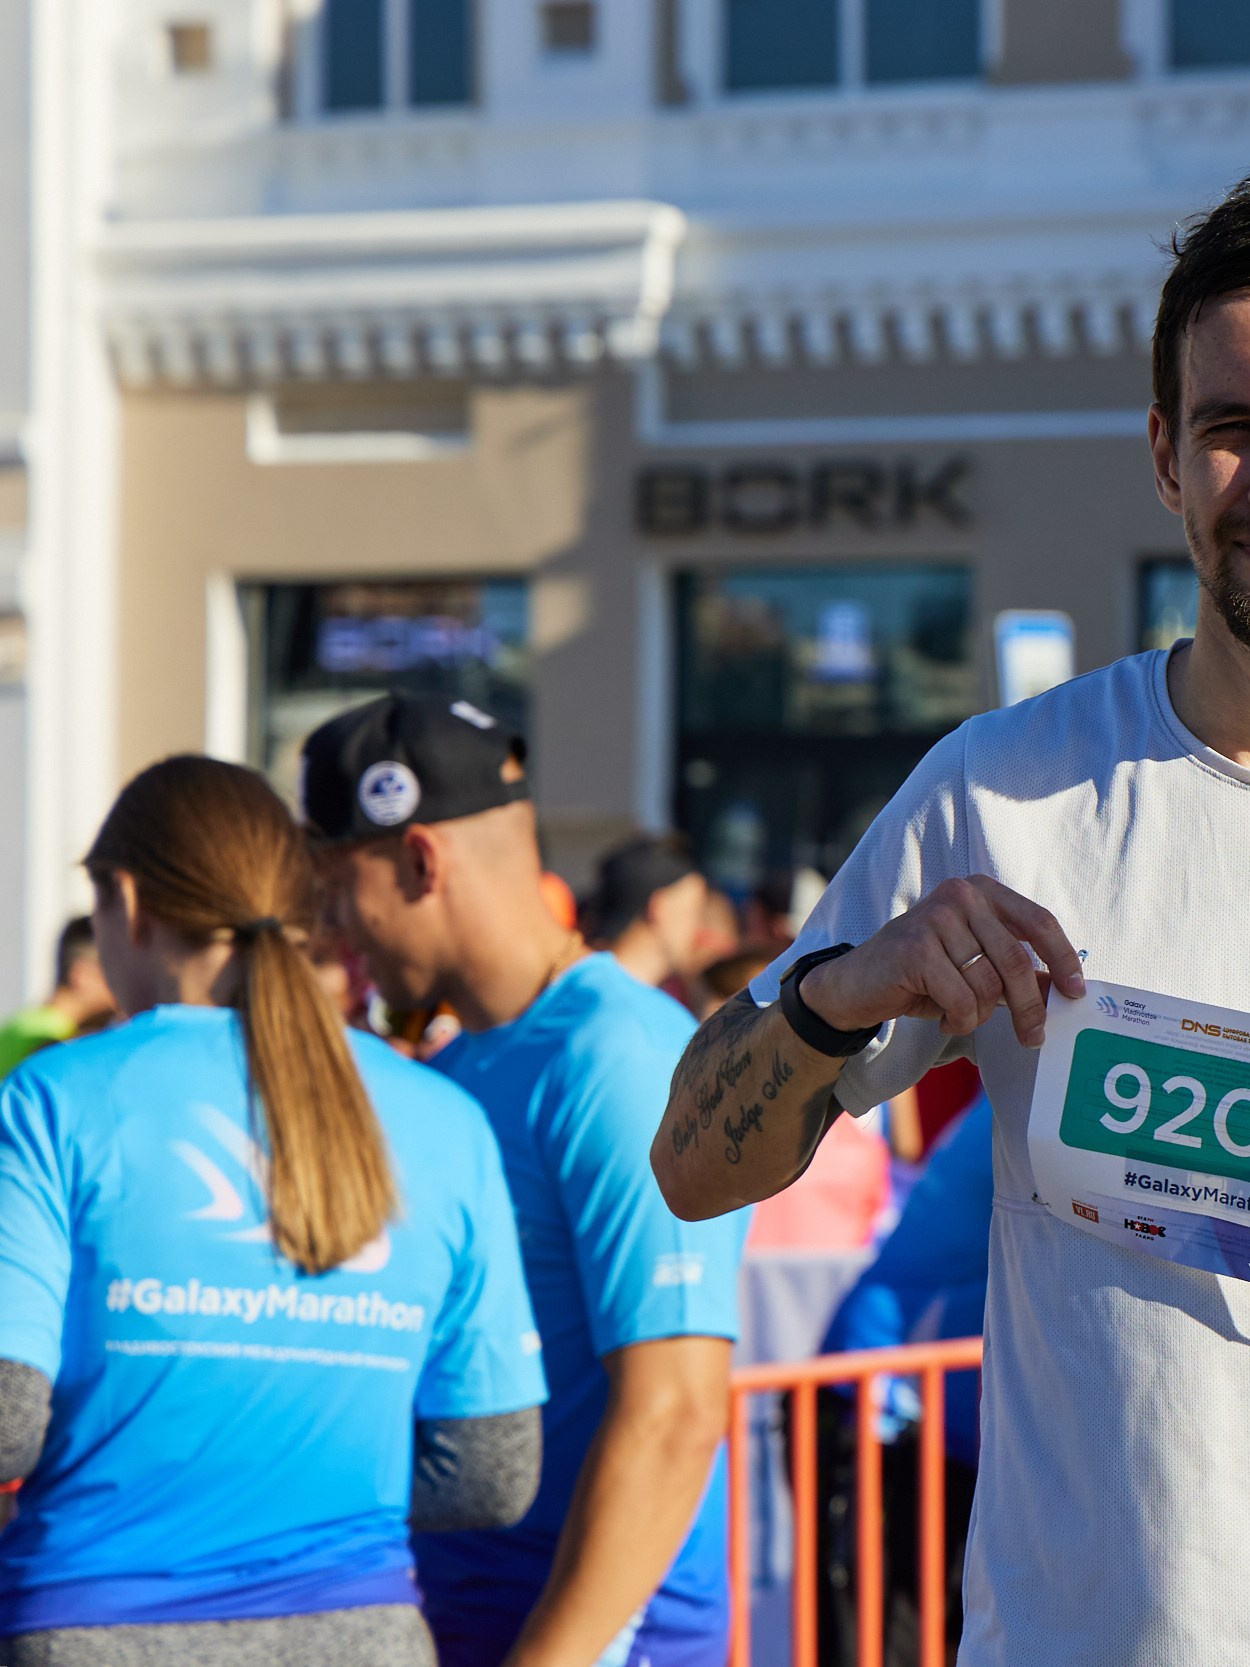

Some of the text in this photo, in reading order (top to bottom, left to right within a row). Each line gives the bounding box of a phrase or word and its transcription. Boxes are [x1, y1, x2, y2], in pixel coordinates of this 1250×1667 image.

[635, 453, 975, 537] BORK
[1122, 1007, 1158, 1021] Vladivostok
[1124, 999, 1146, 1011] Galaxy
[1122, 1014, 1150, 1026] Marathon
[1181, 1018, 1222, 1037] DNS
[724, 1103, 763, 1165] Judge
[106, 1277, 426, 1333] #GalaxyMarathon
